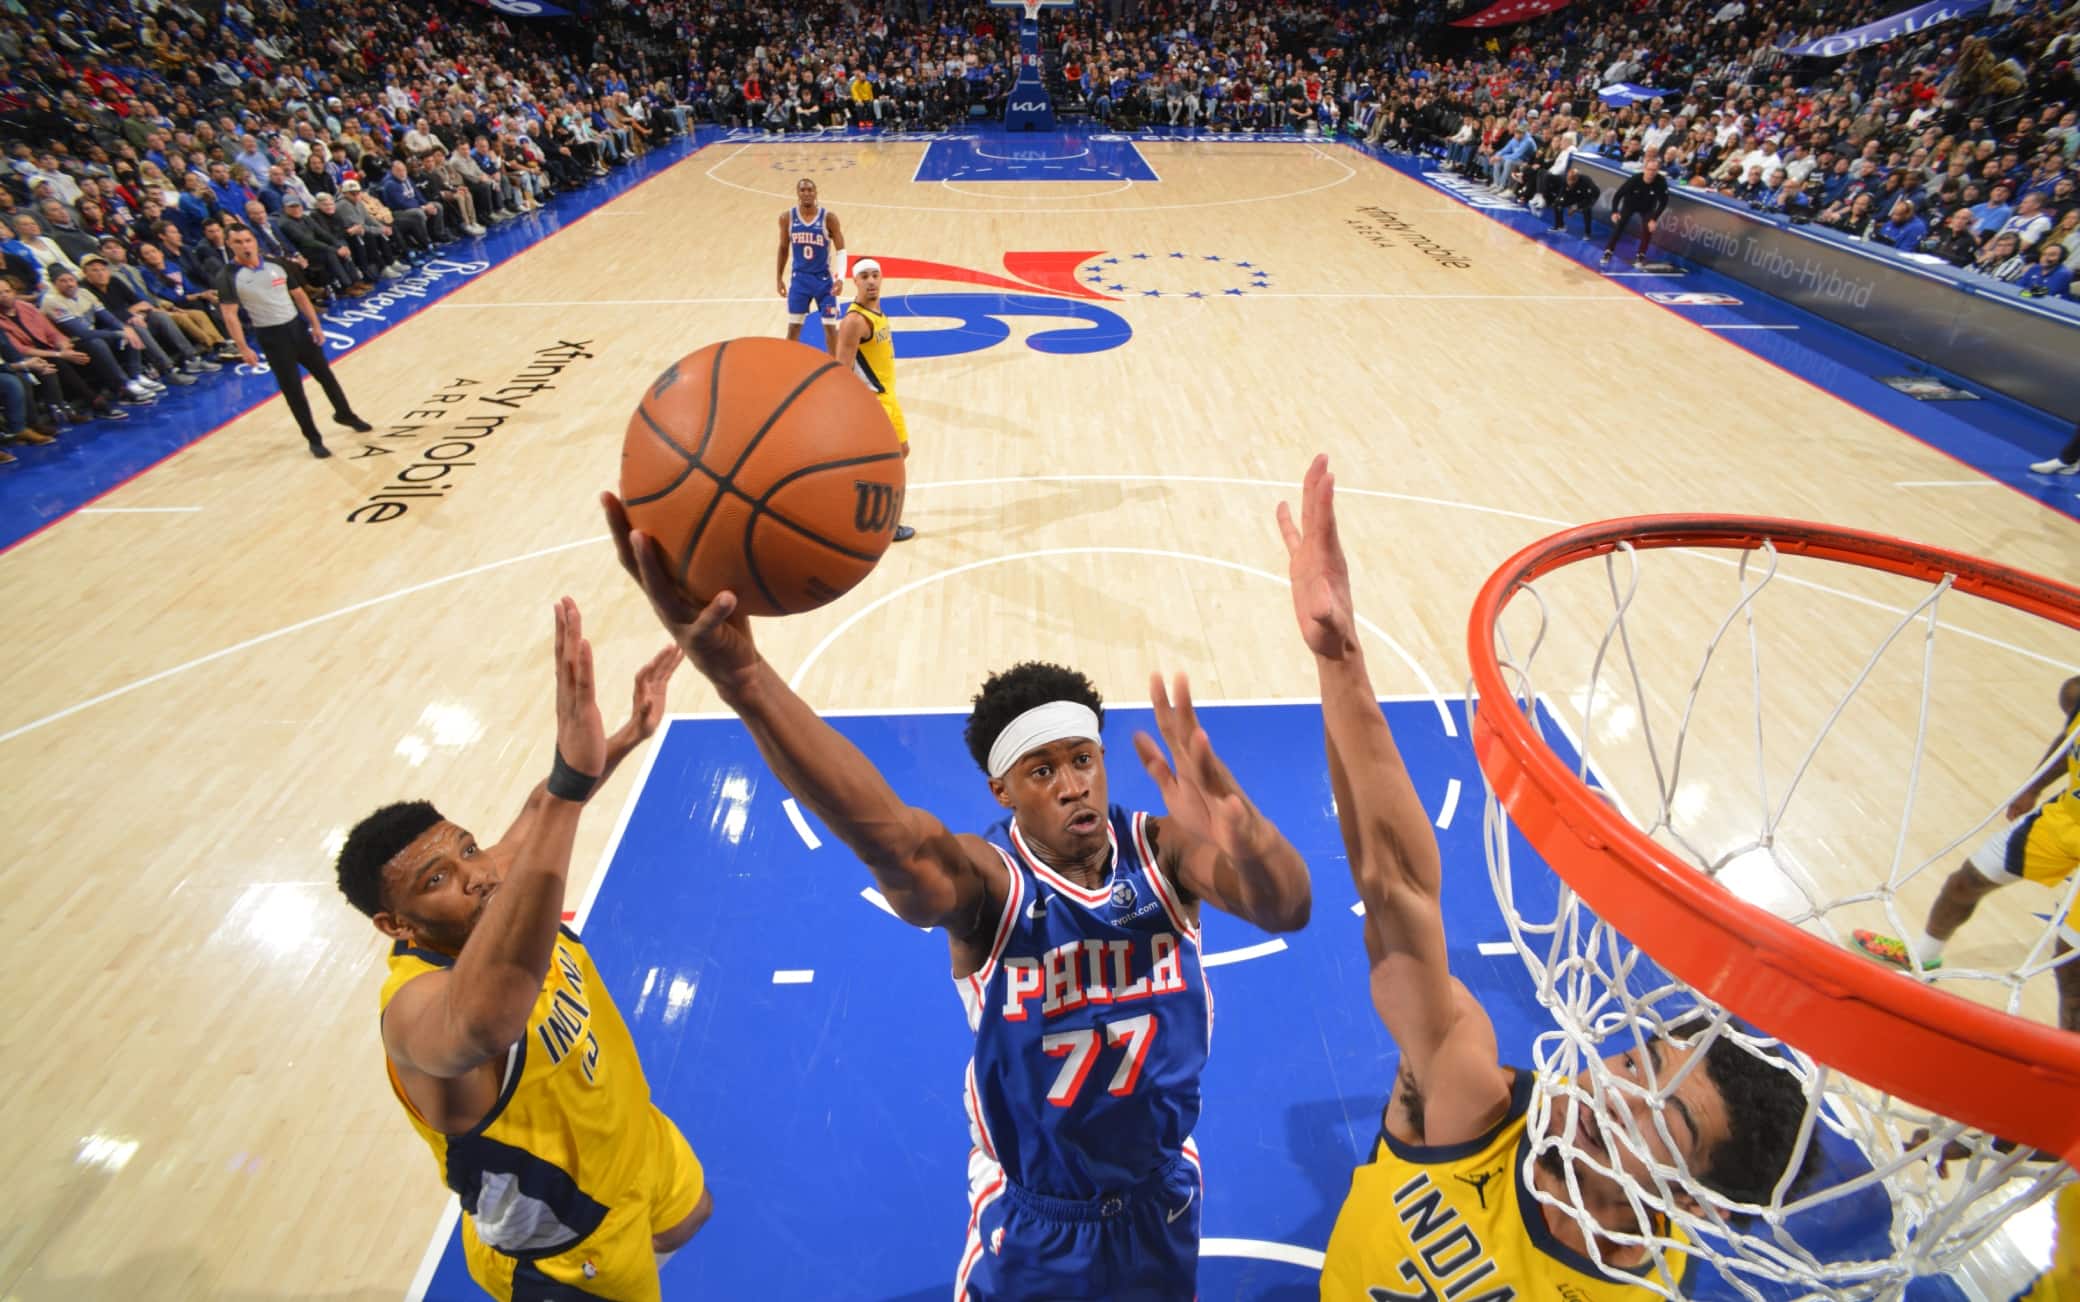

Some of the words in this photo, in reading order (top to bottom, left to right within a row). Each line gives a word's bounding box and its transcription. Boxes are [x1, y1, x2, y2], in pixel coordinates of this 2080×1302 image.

[792, 232, 824, 247] PHILA
[803, 245, 814, 260] 0
[1680, 214, 1739, 257] Sorento
[1743, 237, 1875, 310] Turbo-Hybrid
[322, 258, 490, 329] Brotherly
[479, 338, 594, 409] xfinity
[349, 377, 482, 460] ARENA
[346, 414, 513, 524] mobile
[1003, 932, 1187, 1022] PHILA
[1042, 1014, 1158, 1108] 77
